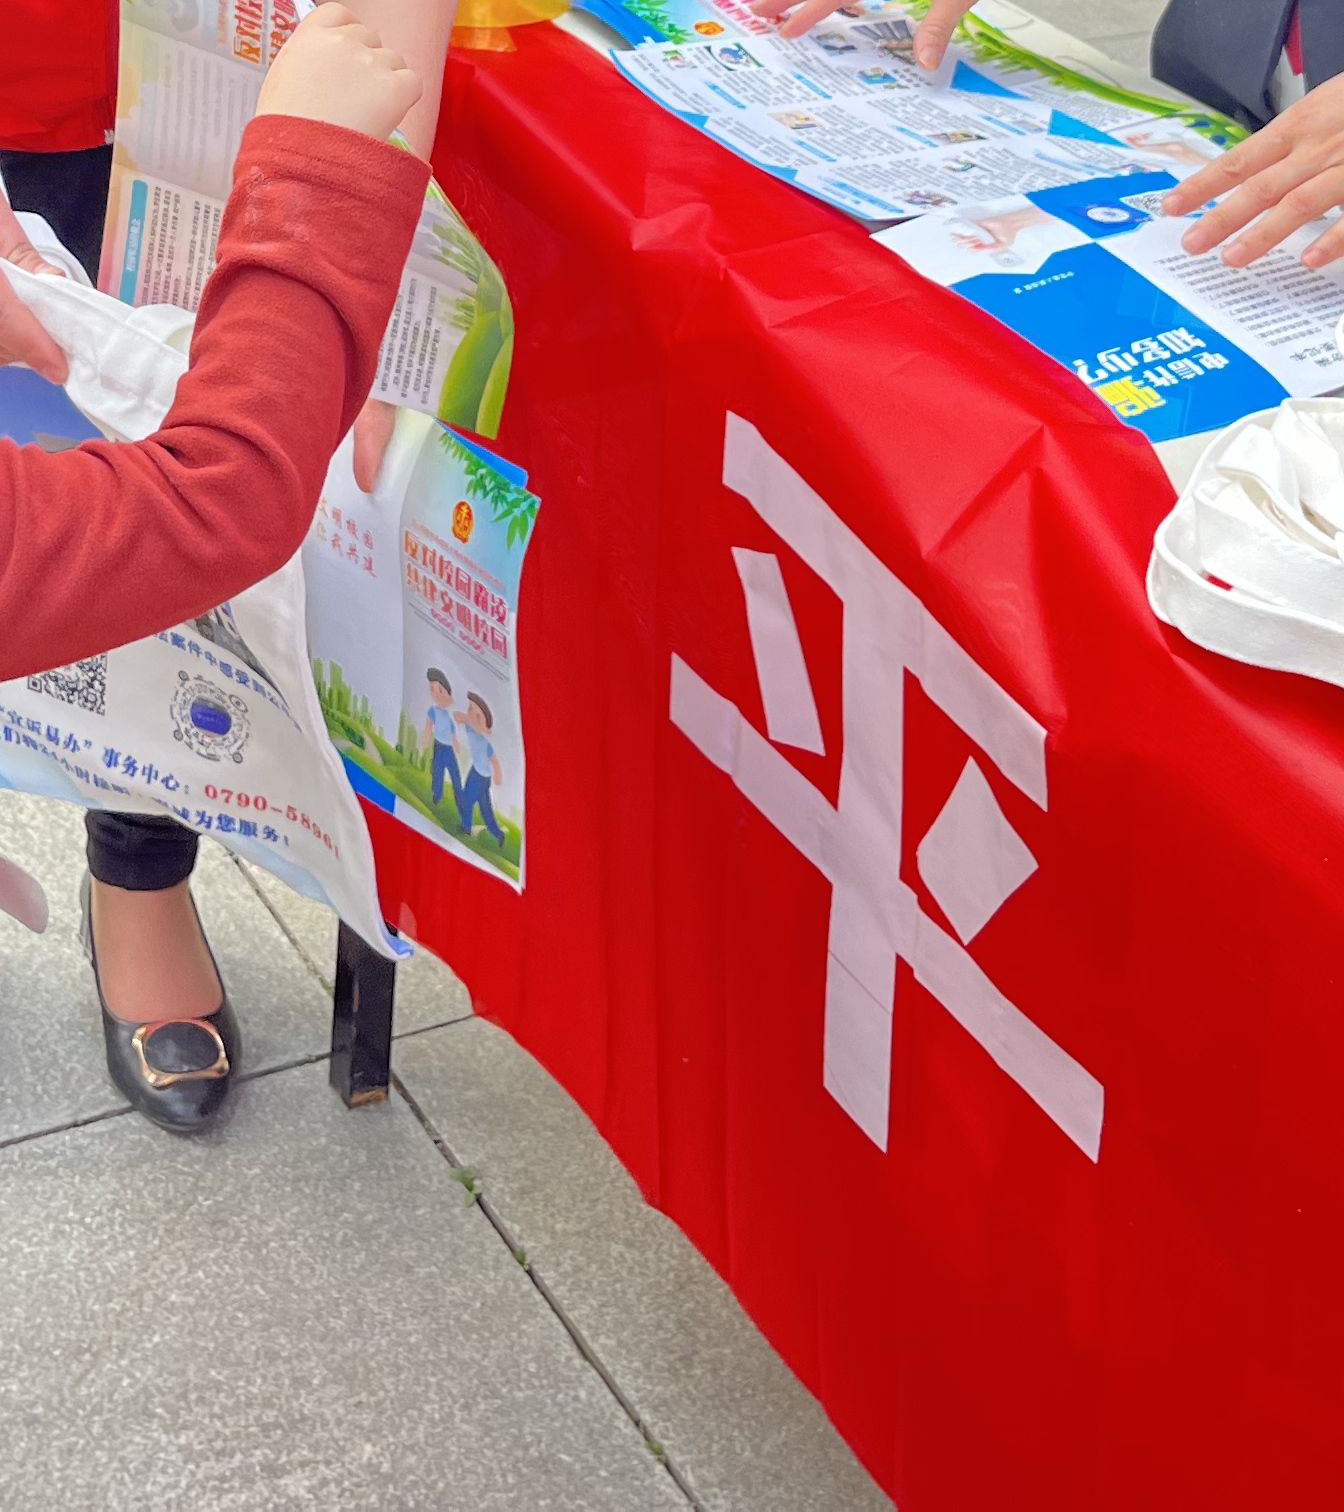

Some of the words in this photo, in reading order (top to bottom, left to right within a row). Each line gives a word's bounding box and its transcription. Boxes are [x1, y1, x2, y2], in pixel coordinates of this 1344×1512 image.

[1092, 353, 1228, 418] 电信诈骗
[404, 530, 508, 626] 反对校园霸凌
[405, 562, 508, 659] 共建文明校园
